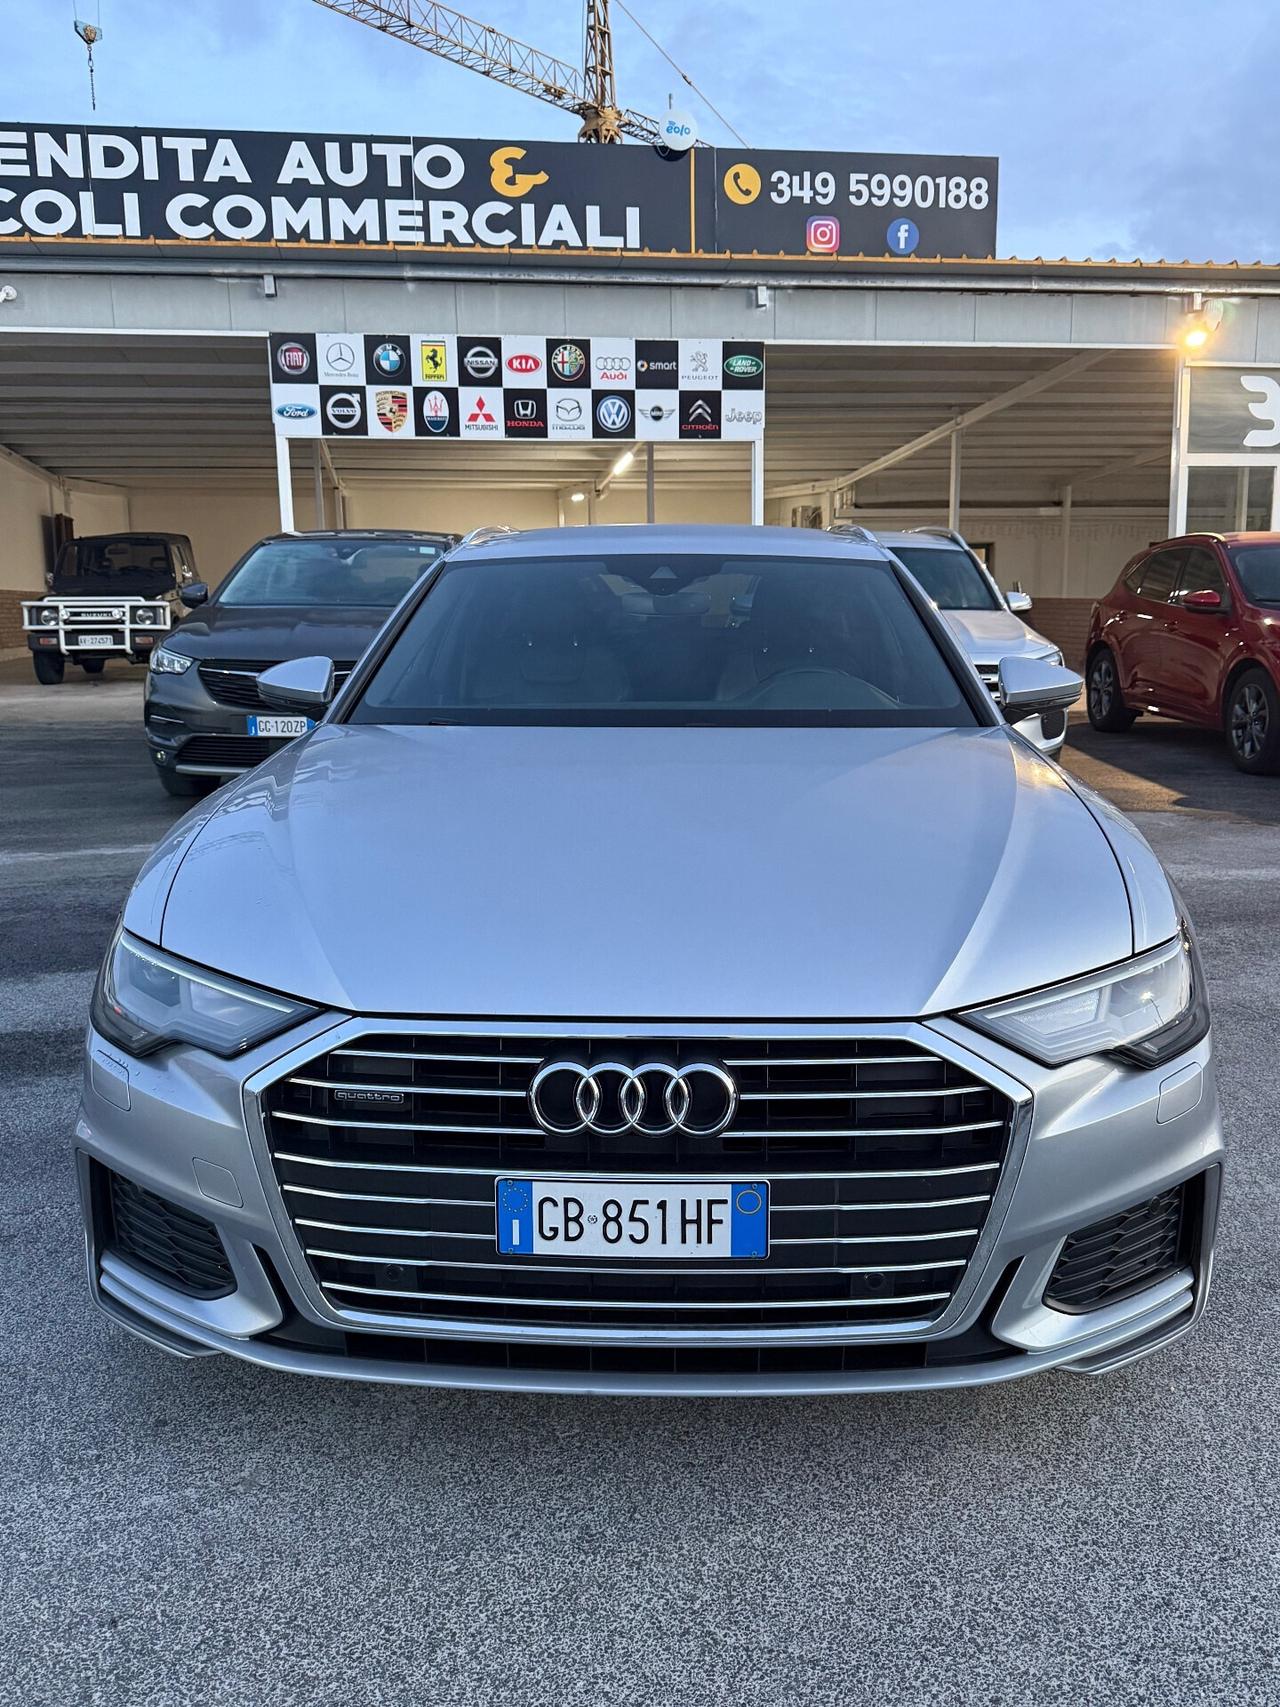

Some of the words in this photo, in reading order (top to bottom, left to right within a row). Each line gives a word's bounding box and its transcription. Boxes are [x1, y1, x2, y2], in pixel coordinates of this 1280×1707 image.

[276, 140, 466, 190] AUTO
[489, 146, 550, 198] &
[770, 170, 837, 206] 349
[848, 173, 989, 211] 5990188
[165, 193, 641, 249] COMMERCIALI
[375, 343, 403, 356] BMW
[285, 352, 304, 366] FIAT
[512, 358, 536, 370] KIA
[732, 359, 752, 367] LAND
[649, 360, 677, 371] smart
[733, 366, 758, 374] ROVER
[600, 371, 628, 380] Audi
[283, 406, 309, 418] Ford
[725, 408, 762, 425] Jeep
[464, 424, 499, 432] MITSUBISHI
[507, 420, 545, 428] HONDA
[337, 1092, 400, 1101] quattro
[538, 1196, 585, 1242] GB
[602, 1198, 729, 1245] 851HF
